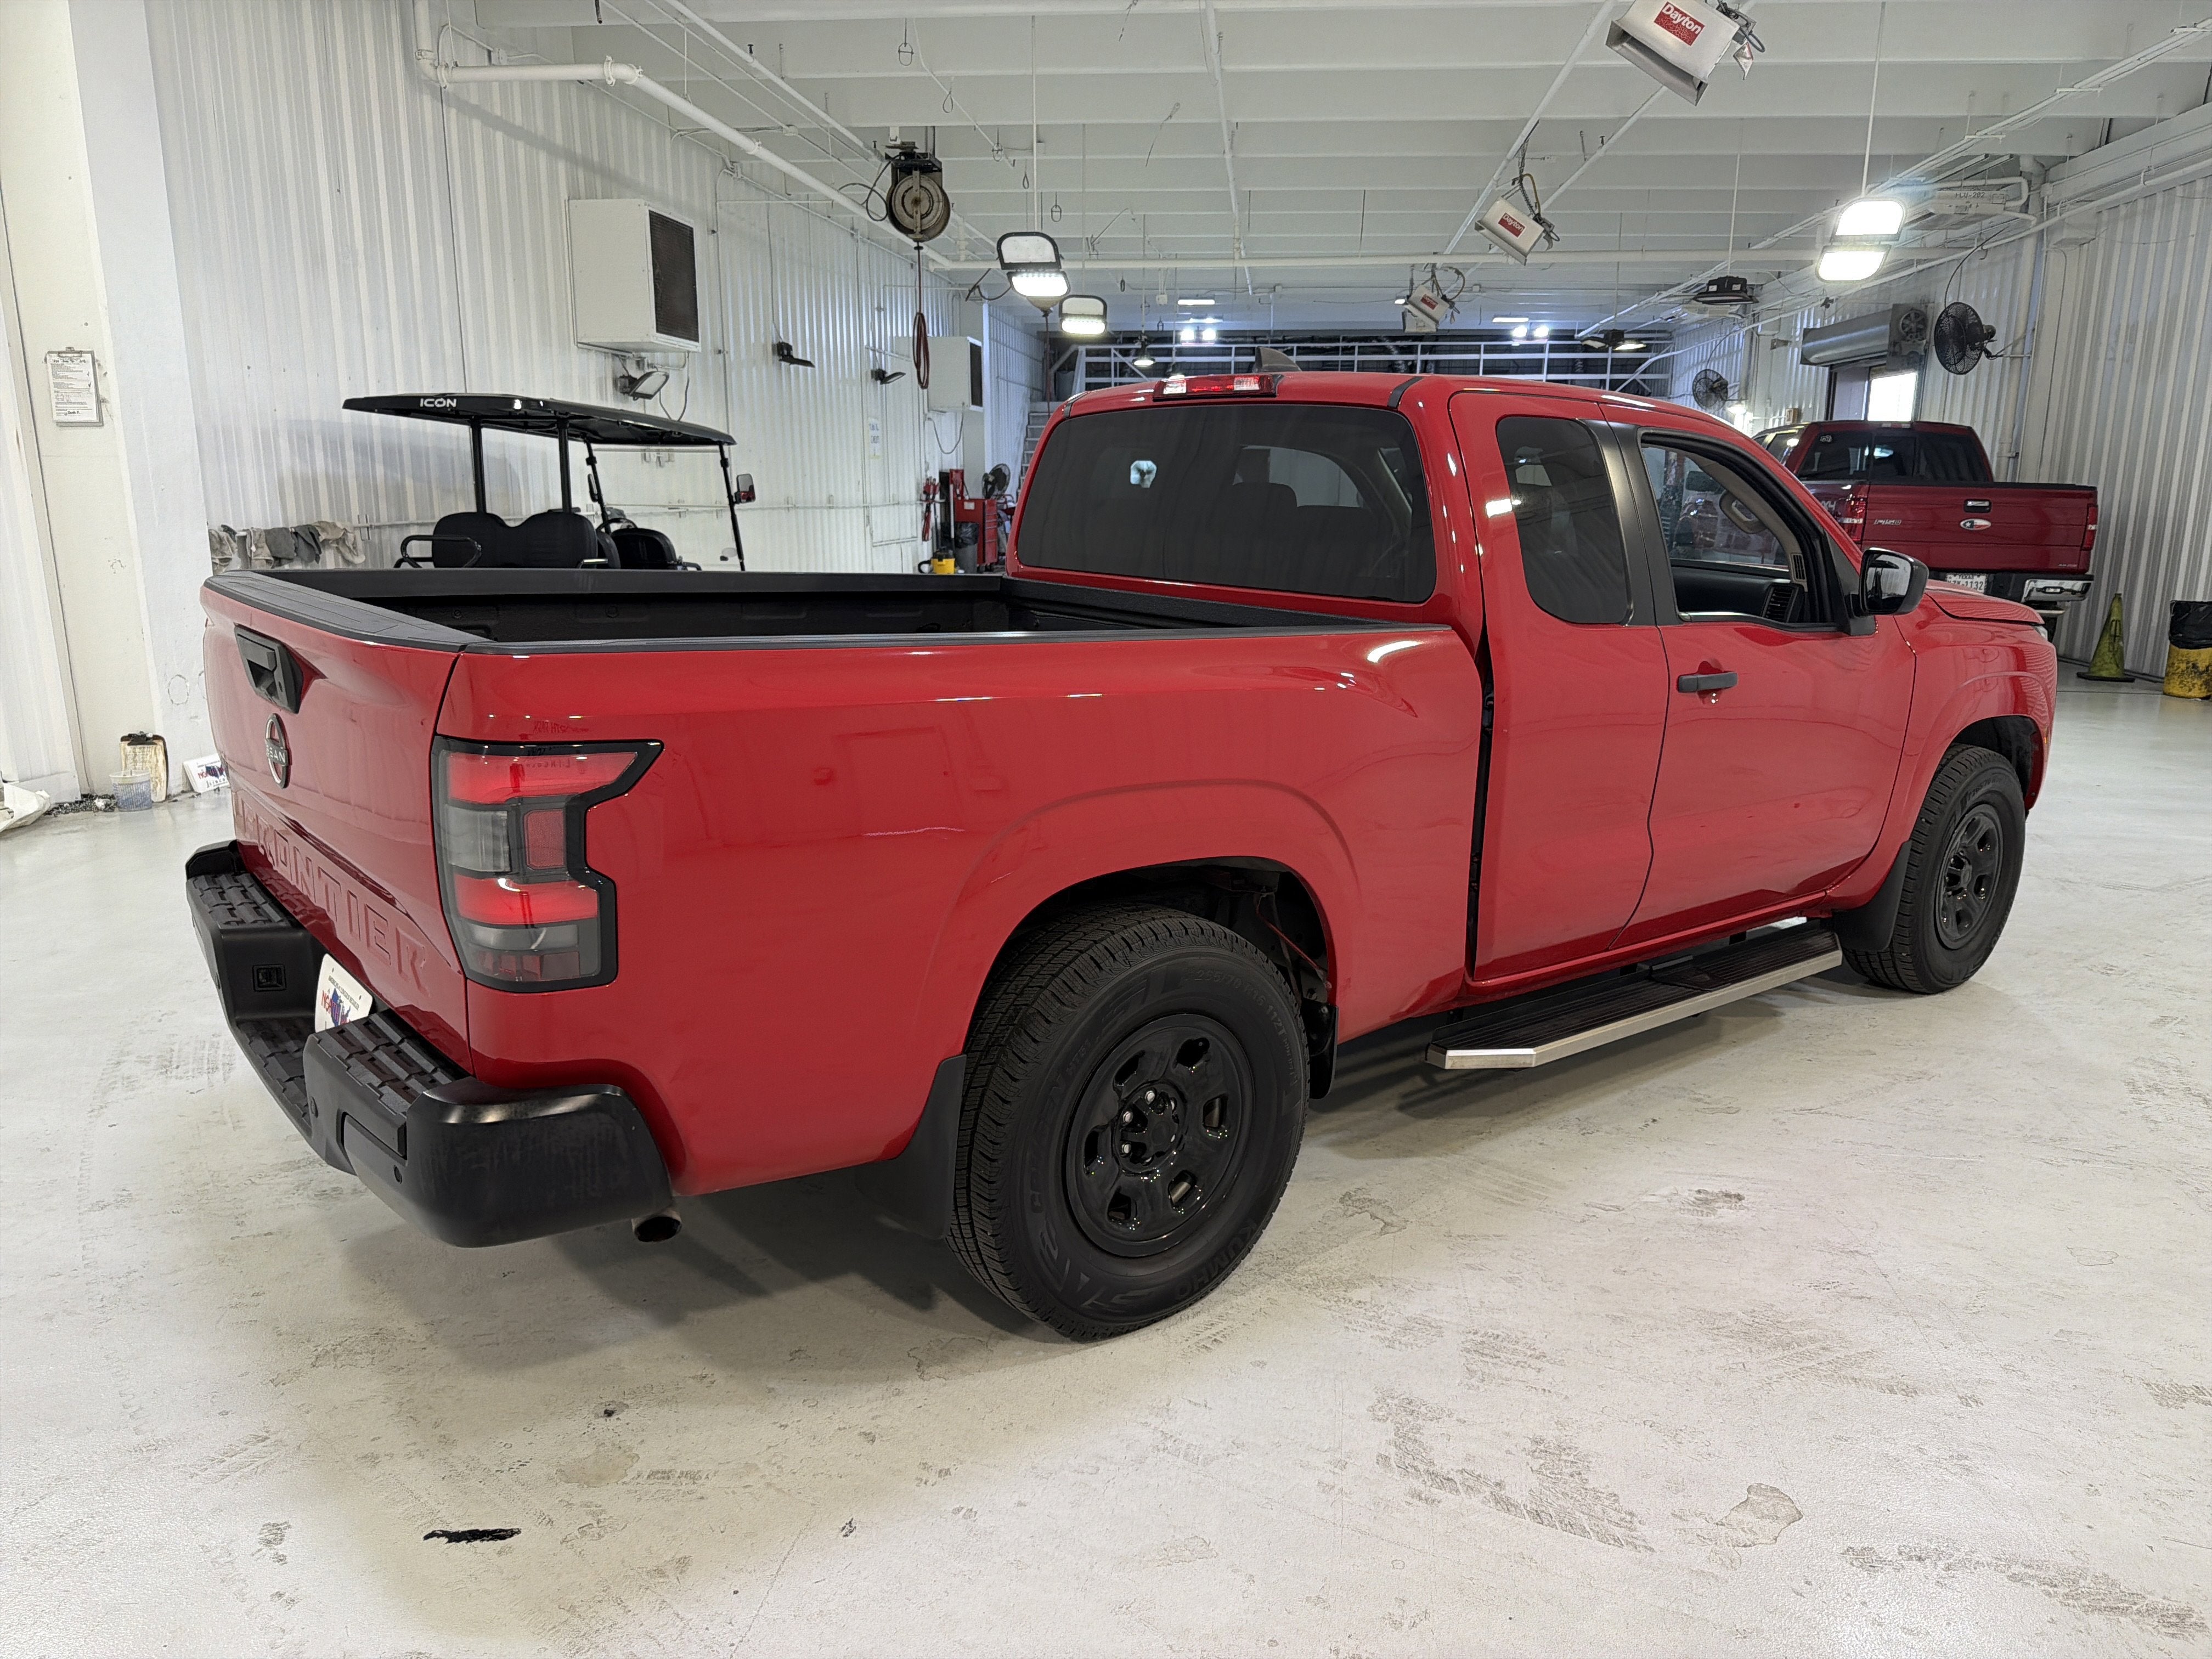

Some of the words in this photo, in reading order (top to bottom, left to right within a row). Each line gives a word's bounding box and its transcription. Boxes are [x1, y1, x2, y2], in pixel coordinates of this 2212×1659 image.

[1662, 3, 1702, 35] Dayton
[1503, 214, 1523, 232] Dayton
[420, 398, 457, 408] ICON
[1821, 500, 1837, 511] X4
[239, 797, 431, 1000] FRONTIER
[1177, 1219, 1260, 1299] KUMHO
